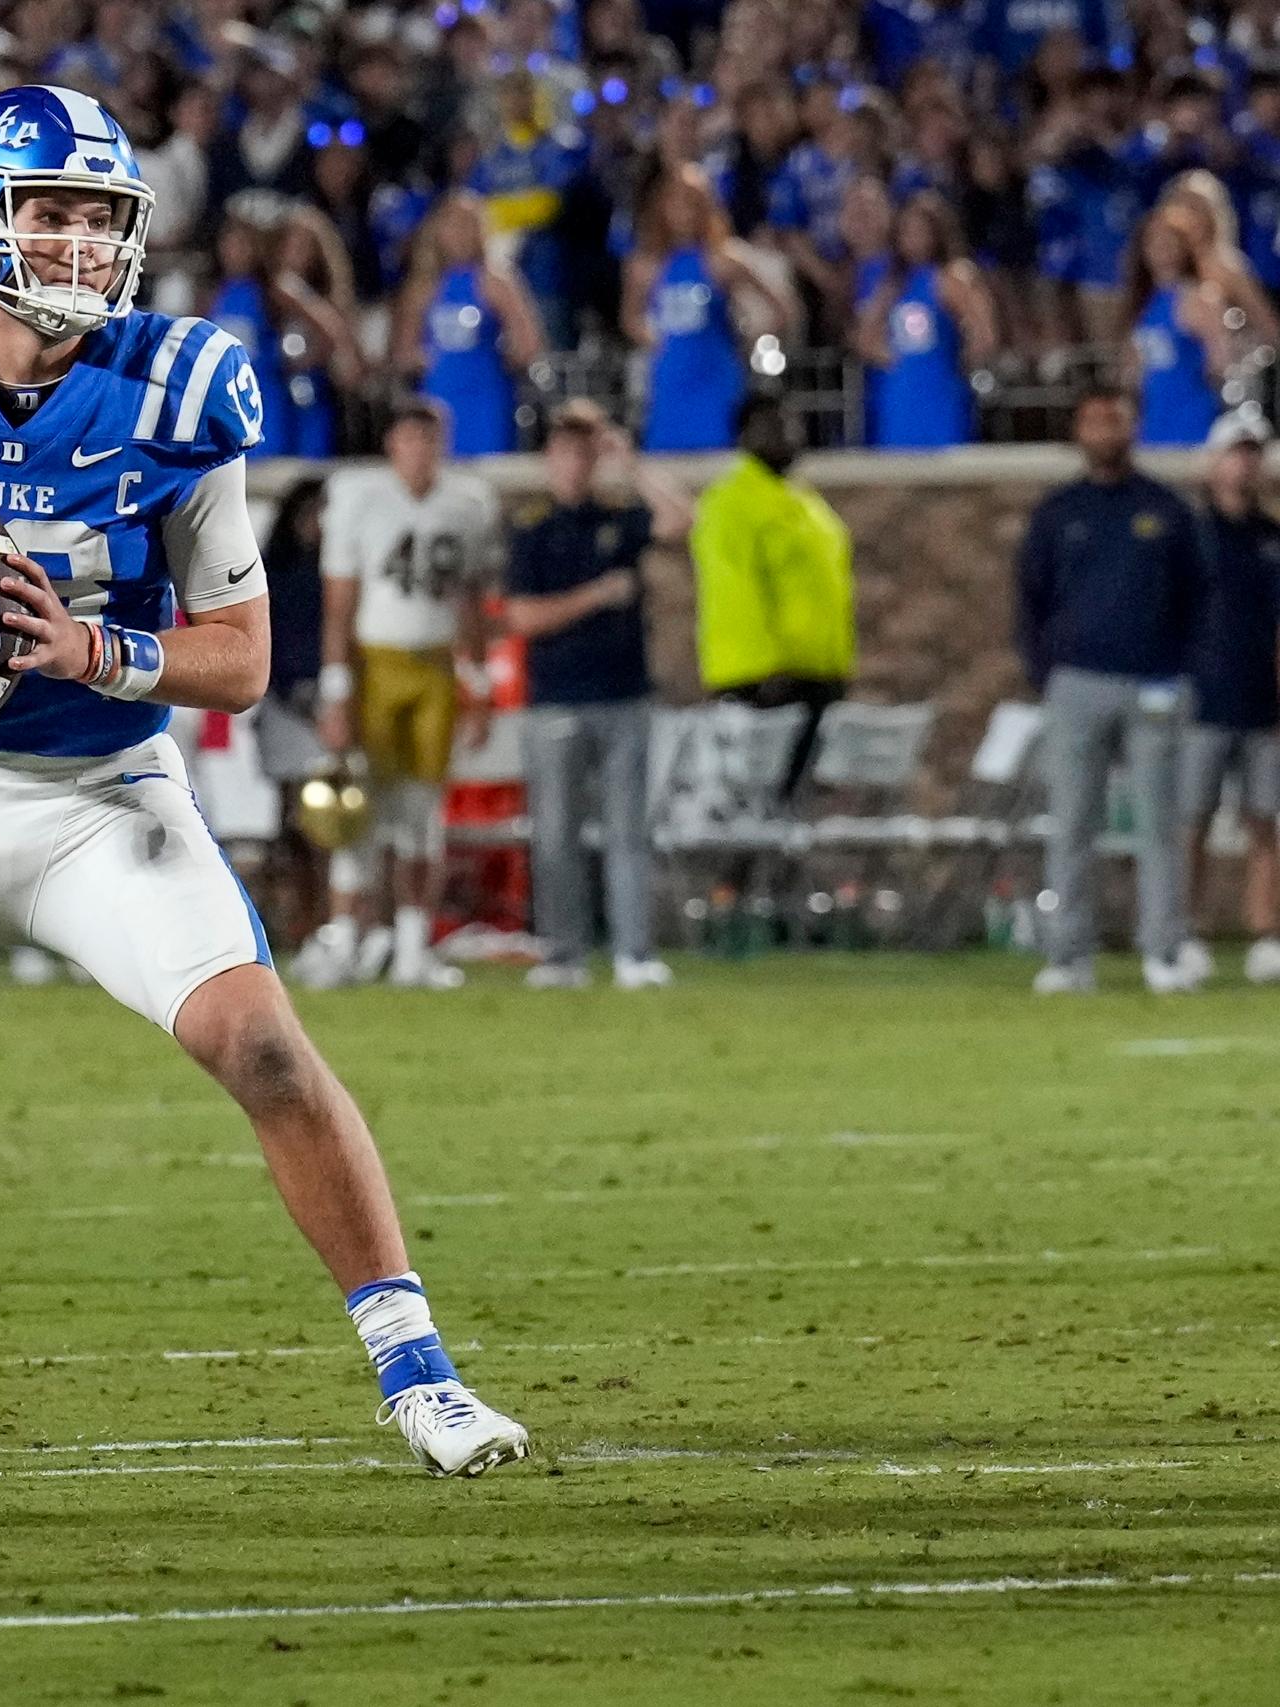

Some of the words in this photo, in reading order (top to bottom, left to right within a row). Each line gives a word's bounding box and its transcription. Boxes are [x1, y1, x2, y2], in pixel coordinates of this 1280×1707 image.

[226, 362, 264, 447] 13
[0, 441, 24, 463] D
[115, 471, 142, 515] C
